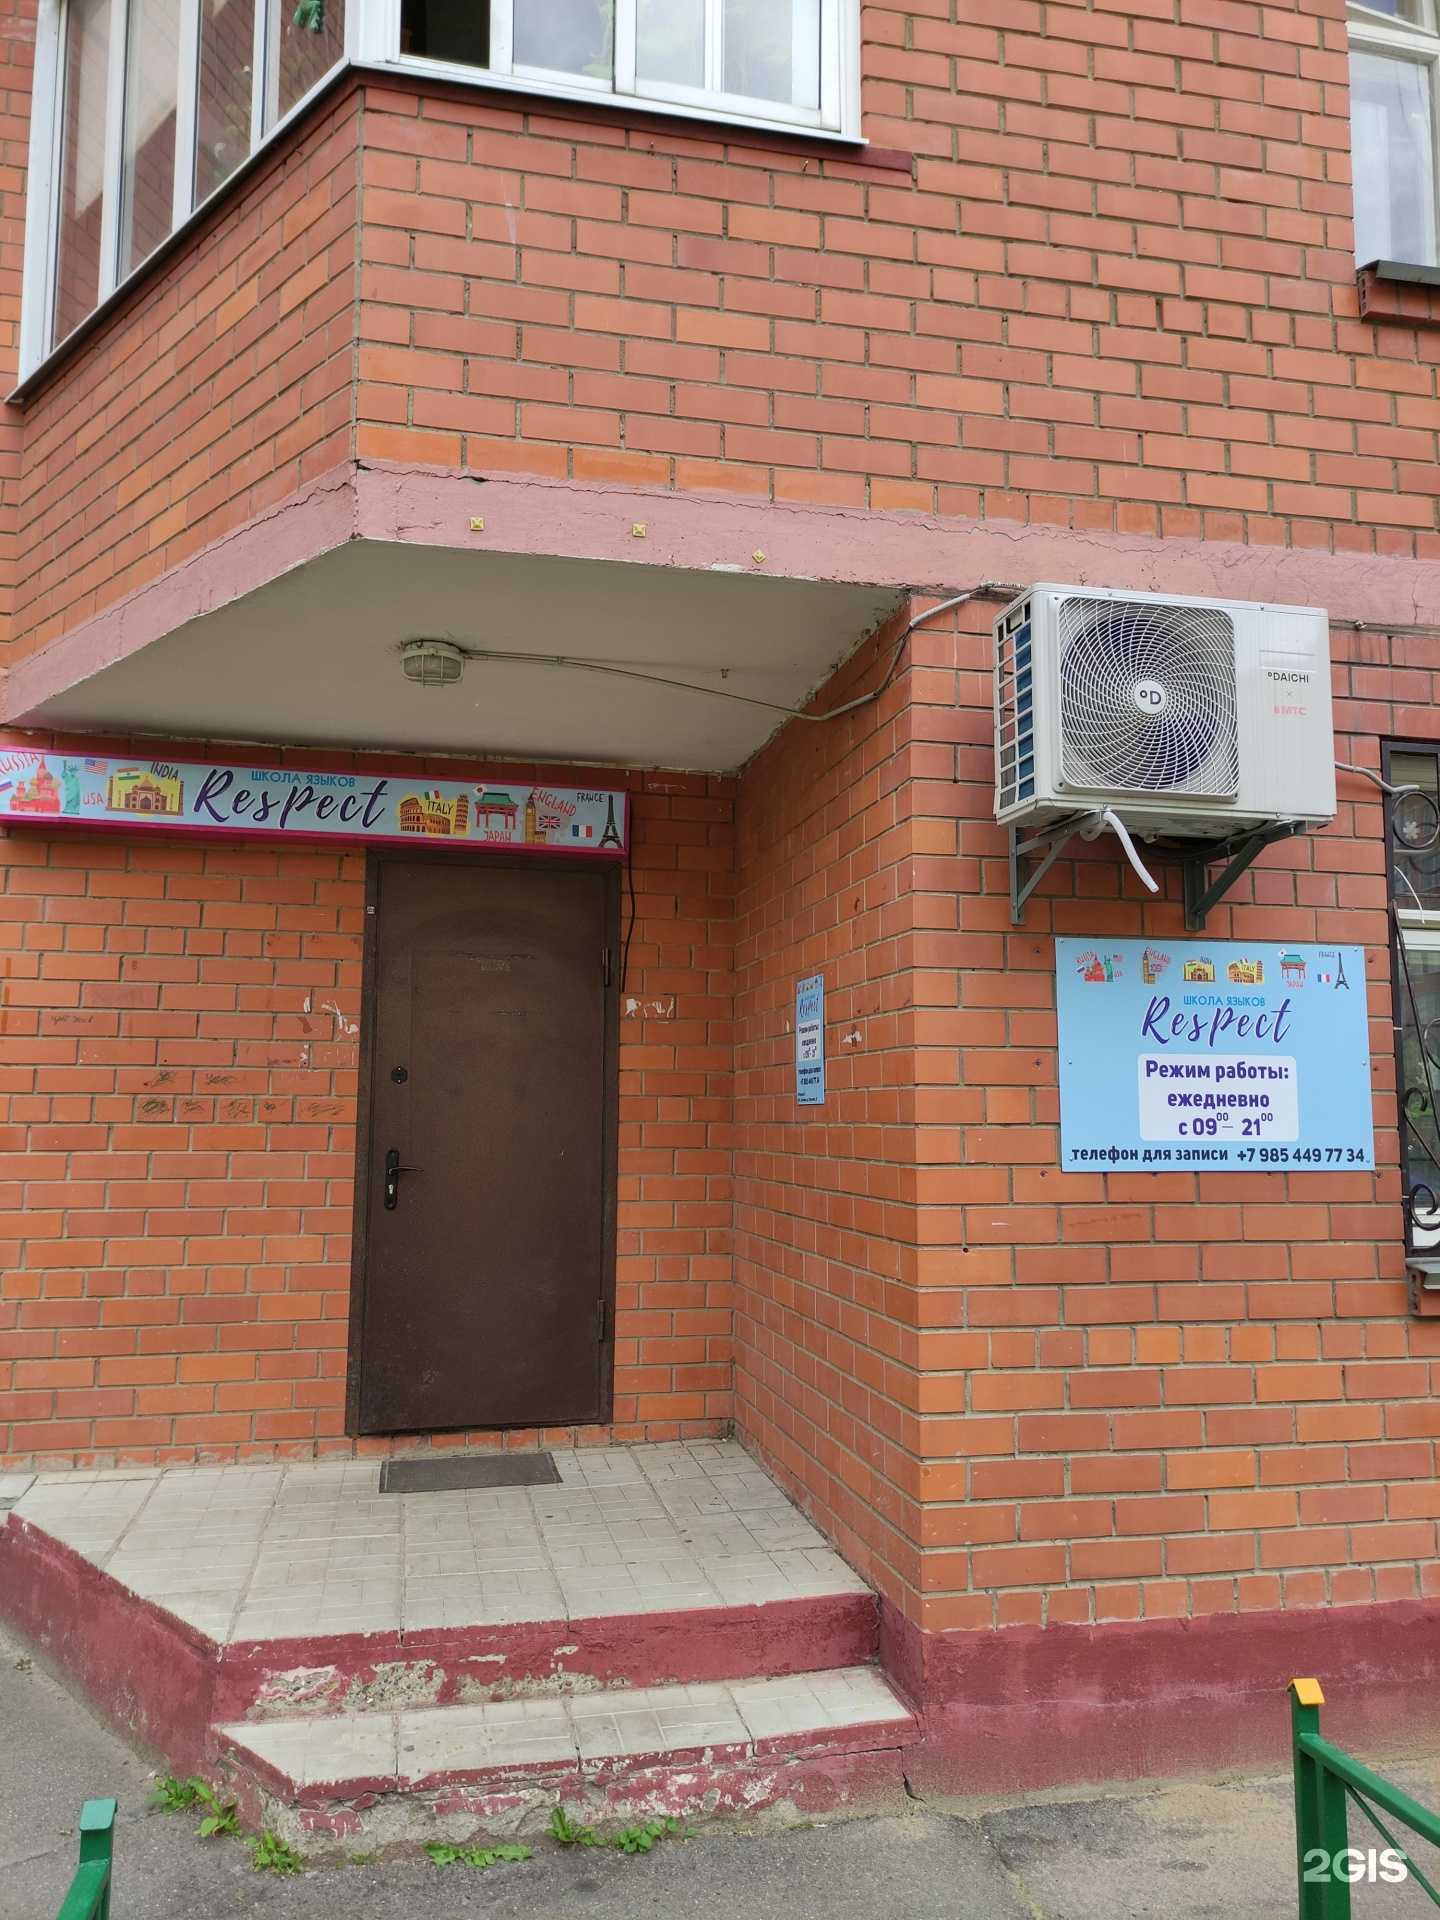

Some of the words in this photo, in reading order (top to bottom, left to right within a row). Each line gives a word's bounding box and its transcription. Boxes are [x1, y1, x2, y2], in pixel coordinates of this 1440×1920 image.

[150, 760, 179, 781] INDIA
[251, 770, 302, 784] ШКОЛА
[306, 774, 356, 788] ЯЗЫКОВ
[82, 792, 105, 805] USA
[193, 768, 389, 829] Respect
[531, 786, 577, 816] ENGLAND
[576, 792, 604, 803] FRANCE
[426, 799, 454, 816] ITALY
[484, 831, 512, 843] JAPAN
[1183, 995, 1224, 1006] ШКОЛА
[1226, 996, 1266, 1007] ЯЗЫКОВ
[1141, 996, 1293, 1047] Respect
[1145, 1060, 1211, 1078] Режим
[1215, 1061, 1289, 1082] работы:
[1167, 1093, 1270, 1109] ежедневно
[1178, 1121, 1188, 1135] с
[1072, 1146, 1139, 1163] телефон
[1142, 1149, 1171, 1163] для
[1175, 1149, 1228, 1161] записи
[1237, 1148, 1255, 1162] +7
[1259, 1148, 1289, 1163] 985
[1292, 1149, 1322, 1163] 449
[1325, 1149, 1343, 1163] 77
[1346, 1149, 1365, 1163] 34
